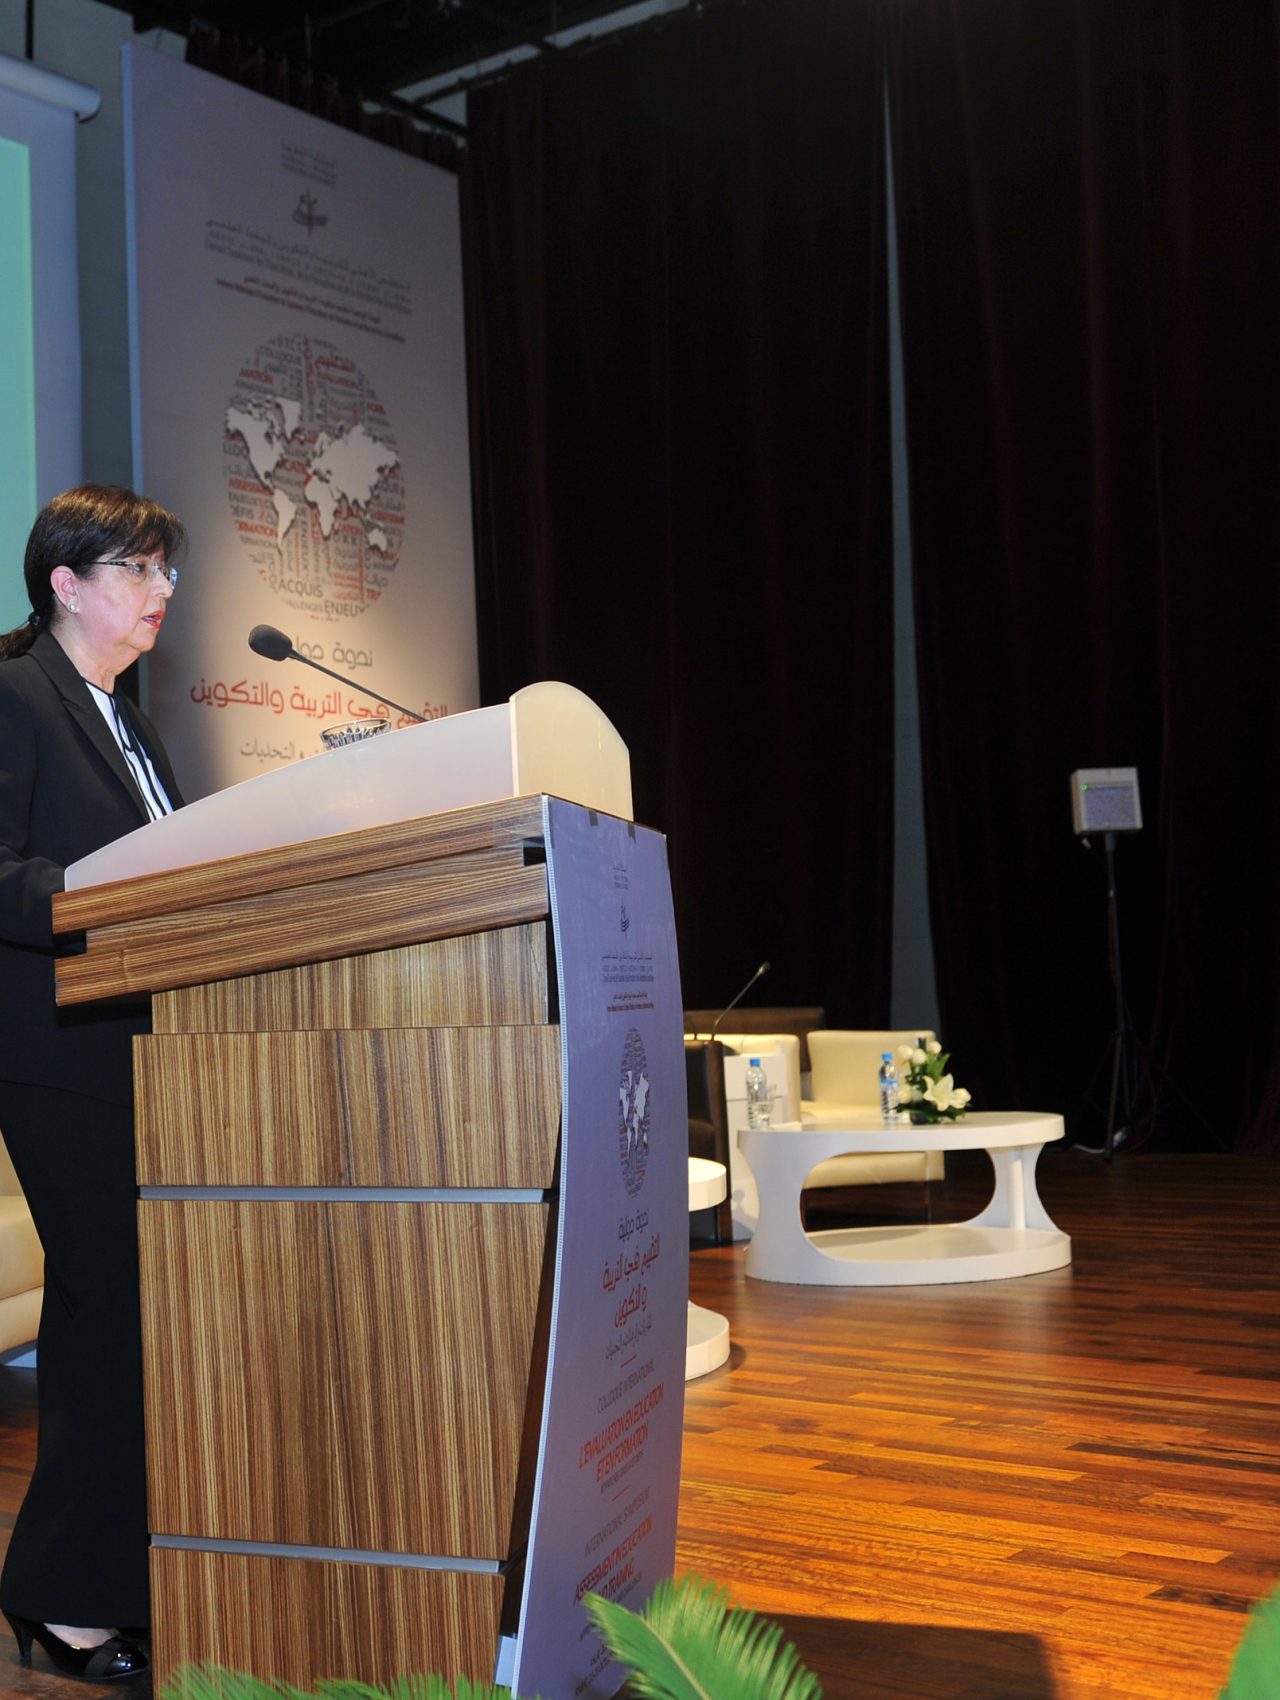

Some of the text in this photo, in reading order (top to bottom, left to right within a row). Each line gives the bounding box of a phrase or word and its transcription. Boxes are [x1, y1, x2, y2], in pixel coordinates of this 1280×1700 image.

[279, 578, 325, 599] ACQUIS
[332, 641, 373, 670] ندوة
[189, 678, 285, 715] والتكوين
[290, 685, 342, 720] التربية
